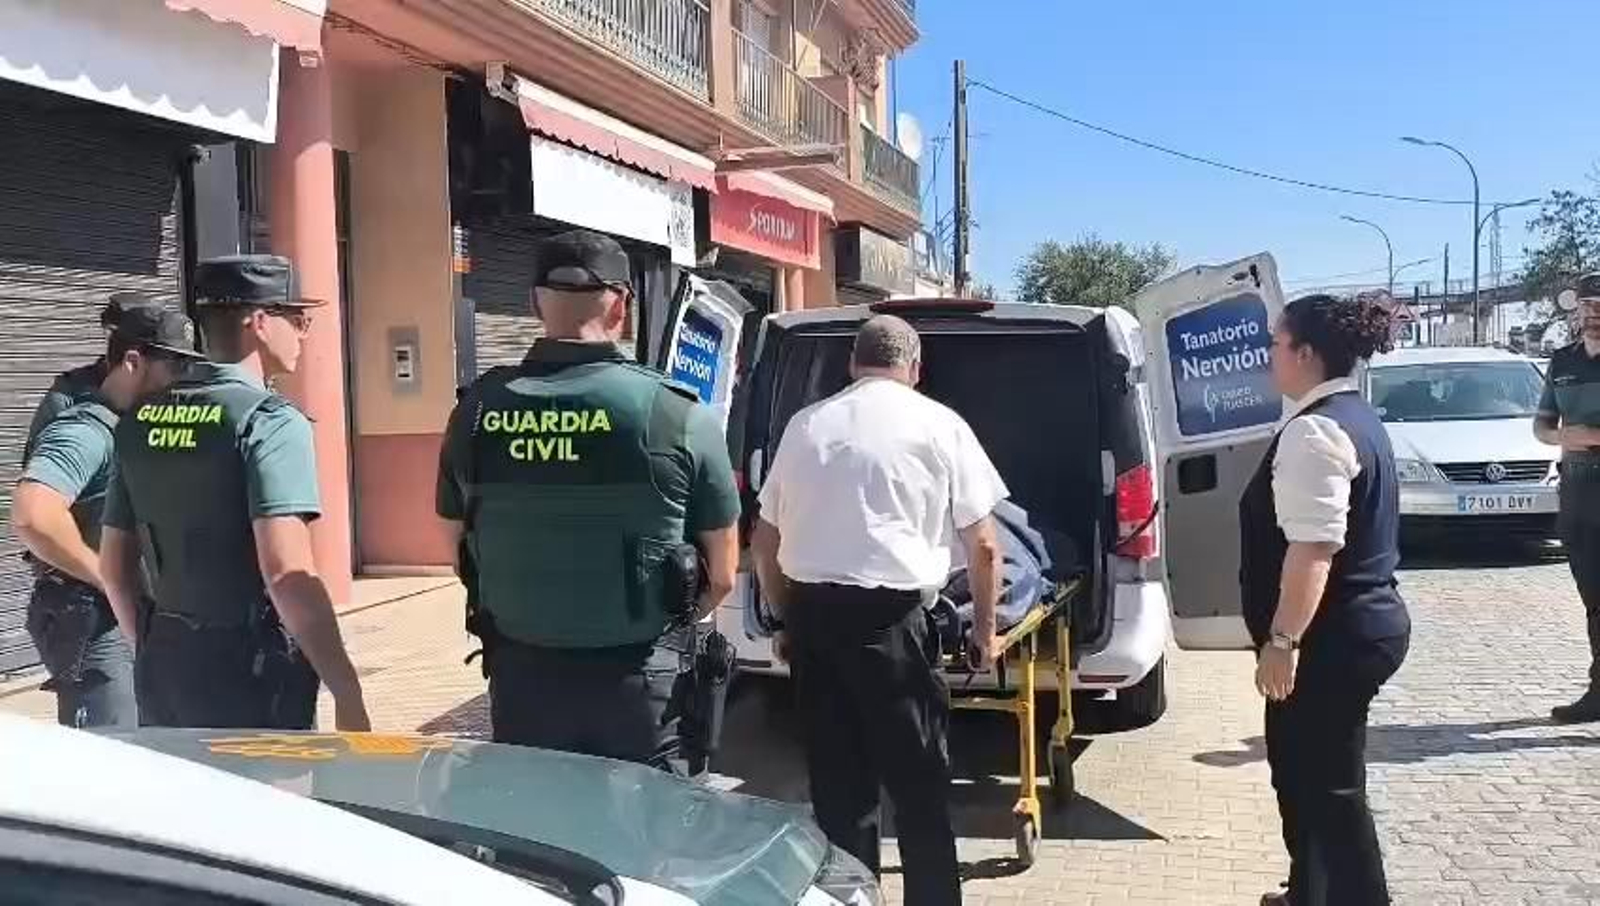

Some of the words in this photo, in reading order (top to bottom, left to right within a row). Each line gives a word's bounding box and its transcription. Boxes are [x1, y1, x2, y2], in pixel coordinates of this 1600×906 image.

[1180, 318, 1259, 351] Tanatorio
[1181, 343, 1269, 381] Nervión
[136, 404, 222, 423] GUARDIA
[482, 408, 612, 433] GUARDIA
[148, 427, 197, 448] CIVIL
[509, 437, 580, 461] CIVIL
